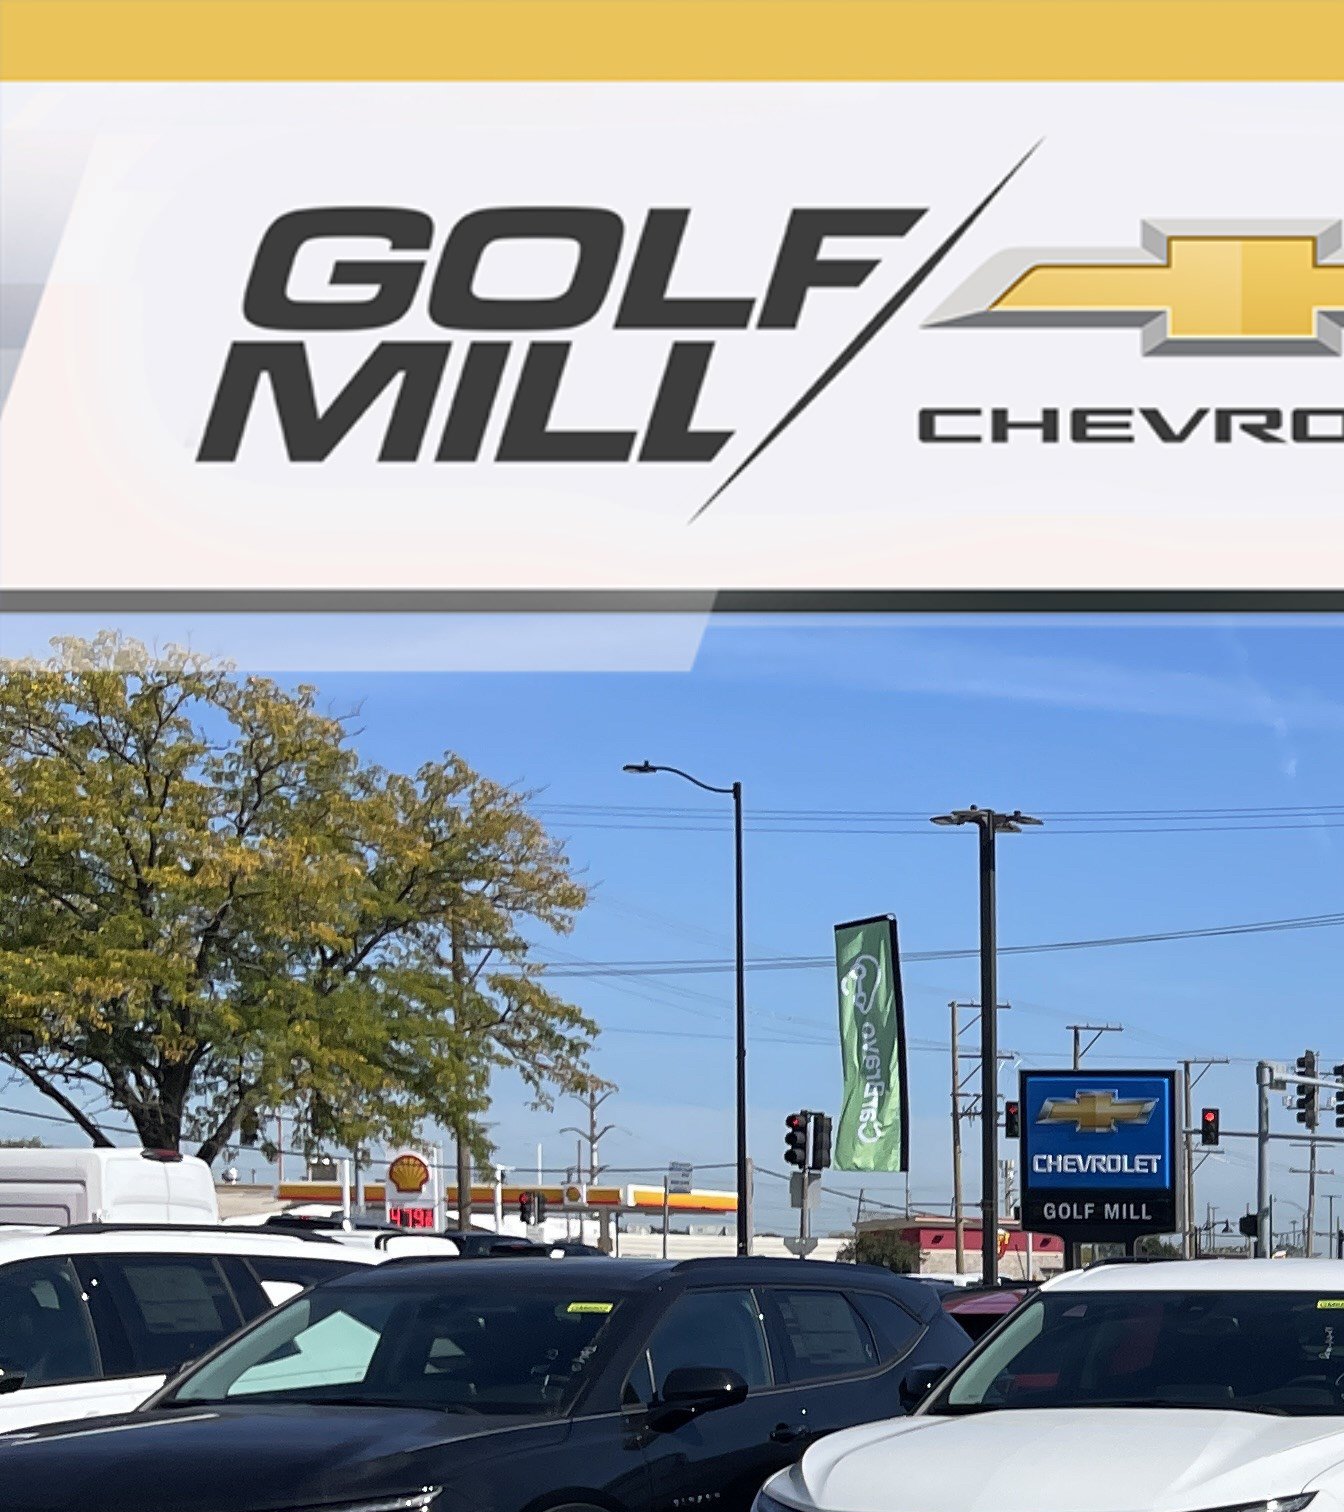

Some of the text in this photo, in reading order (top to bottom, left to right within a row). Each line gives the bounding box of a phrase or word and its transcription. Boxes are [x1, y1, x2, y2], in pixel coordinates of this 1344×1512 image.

[1032, 1154, 1162, 1174] CHEVROLET
[1043, 1202, 1152, 1220] GOLF MILL
